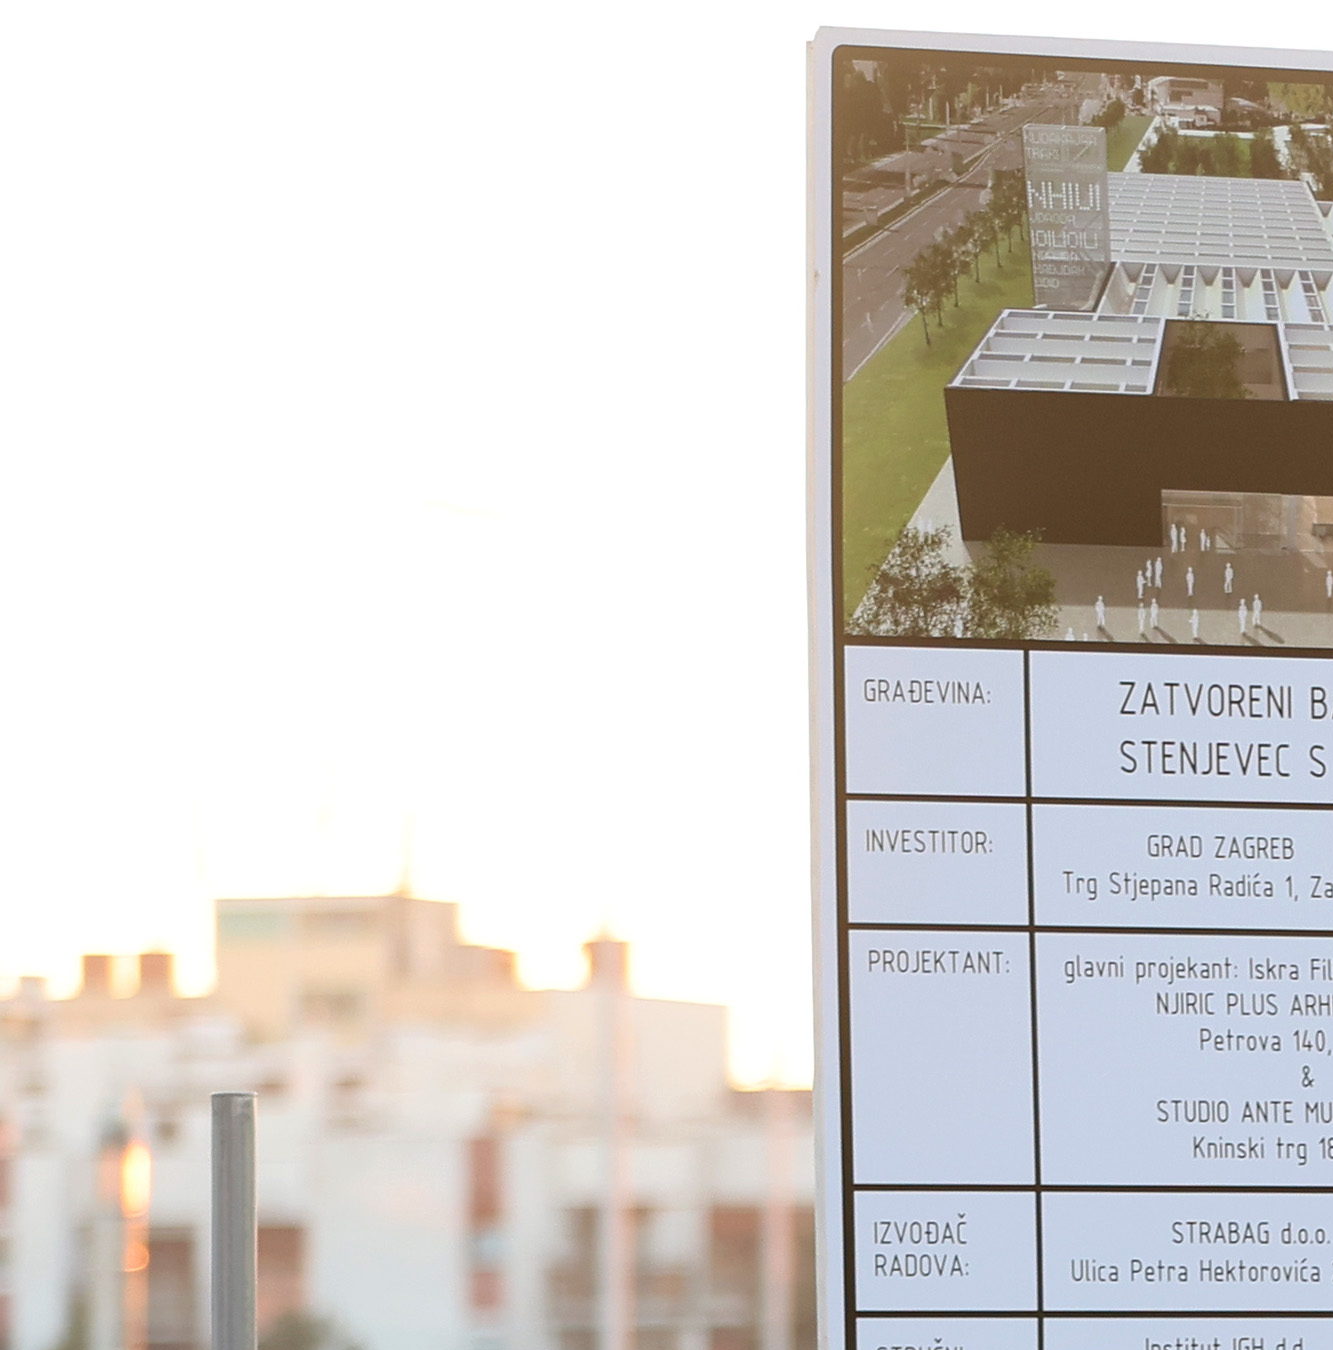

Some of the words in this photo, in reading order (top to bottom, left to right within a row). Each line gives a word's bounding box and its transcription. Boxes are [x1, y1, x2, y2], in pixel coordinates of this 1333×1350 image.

[863, 678, 991, 705] GRAĐEVINA:
[1118, 680, 1292, 719] ZATVORENI
[1119, 739, 1291, 778] STENJEVEC
[1309, 744, 1327, 779] S
[866, 829, 993, 854] INVESTITOR:
[1147, 834, 1203, 859] GRAD
[1213, 835, 1295, 860] ZAGREB
[1062, 870, 1098, 901] Trg
[1108, 871, 1198, 902] Stjepana
[1209, 872, 1274, 898] Radića
[1285, 875, 1299, 902] 1,
[868, 949, 1010, 974] PROJEKTANT:
[1064, 954, 1124, 984] glavni
[1135, 955, 1238, 986] projekant:
[1249, 957, 1300, 981] Iskra
[1156, 991, 1215, 1016] NJIRIC
[1226, 992, 1279, 1017] PLUS
[1199, 1027, 1282, 1052] Petrova
[1292, 1029, 1332, 1057] 140,
[1301, 1064, 1315, 1088] &
[1156, 1099, 1229, 1123] STUDIO
[1241, 1100, 1294, 1124] ANTE
[1192, 1135, 1265, 1160] Kninski
[1276, 1136, 1308, 1167] trg
[873, 1212, 968, 1245] IZVOĐAČ
[1171, 1221, 1270, 1245] STRABAG
[1280, 1221, 1331, 1245] d.o.o.
[874, 1253, 970, 1278] RADOVA:
[1070, 1259, 1119, 1283] Ulica
[1130, 1258, 1189, 1283] Petra
[1199, 1257, 1321, 1283] Hektorovića
